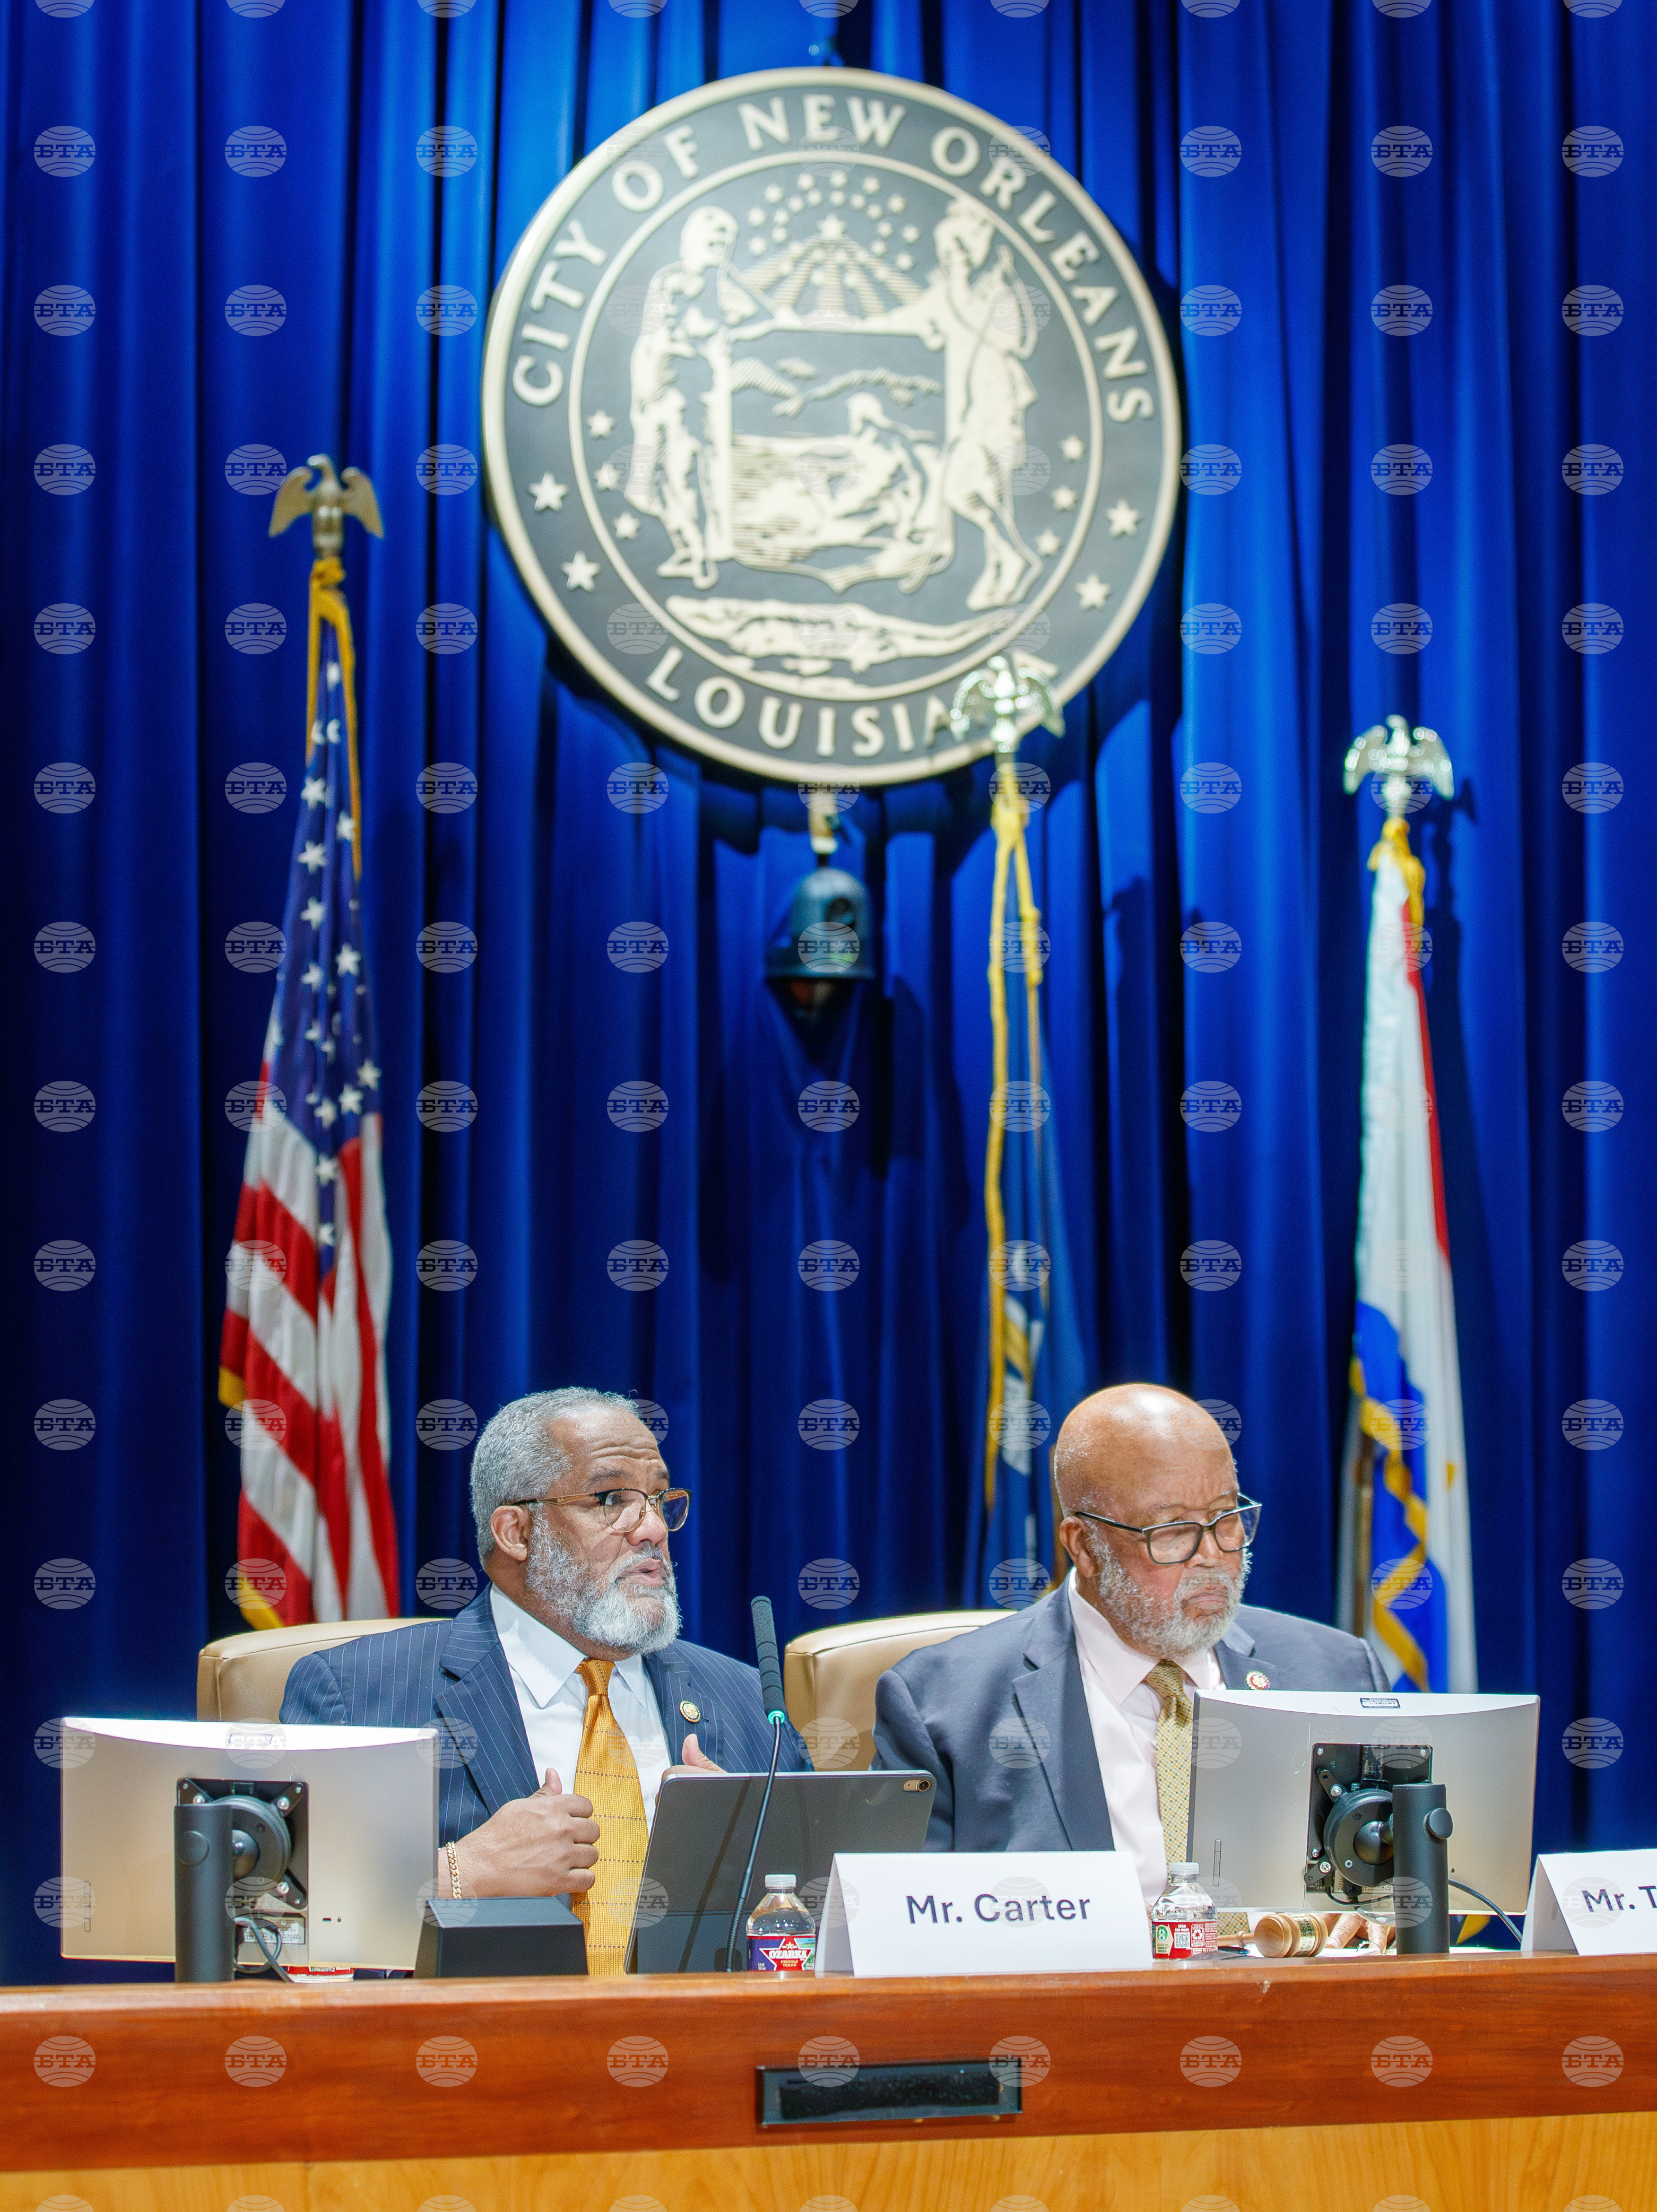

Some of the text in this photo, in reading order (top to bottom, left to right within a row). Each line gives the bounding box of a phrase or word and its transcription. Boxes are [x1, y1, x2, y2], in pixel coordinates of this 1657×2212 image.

[513, 94, 1154, 422] CITY OF NEW ORLEANS
[906, 1893, 1090, 1924] Mr. Carter
[1582, 1889, 1635, 1912] Mr.
[769, 1950, 807, 1959] OZARKA
